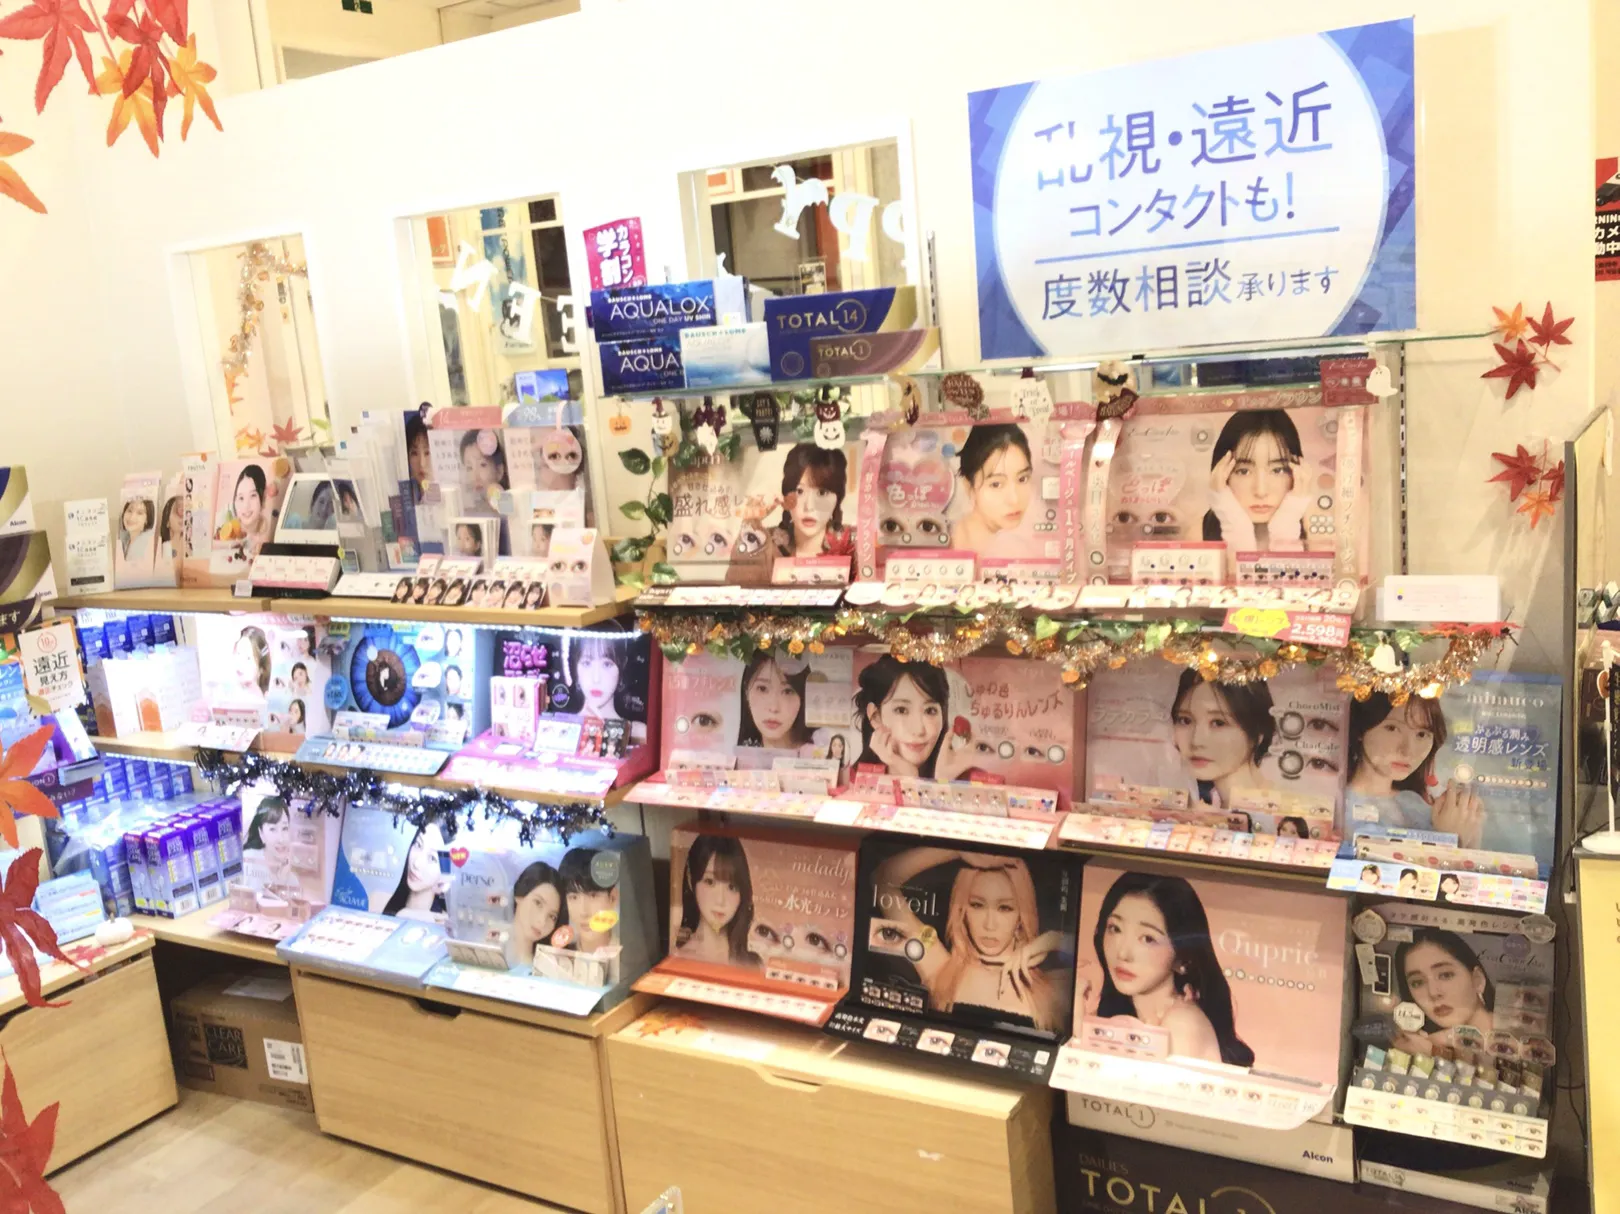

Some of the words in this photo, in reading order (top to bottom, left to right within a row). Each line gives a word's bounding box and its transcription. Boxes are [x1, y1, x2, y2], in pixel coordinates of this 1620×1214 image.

[597, 227, 621, 286] 学割
[617, 225, 634, 283] カラコン
[610, 296, 710, 321] AQUALOX
[653, 317, 667, 325] ONE
[776, 310, 839, 329] TOTAL
[818, 347, 854, 358] TOTAL
[674, 492, 764, 518] 盛れ感レ
[9, 519, 27, 528] Alcon
[33, 651, 70, 676] 遠近
[40, 671, 68, 686] 見え方
[970, 690, 1063, 719] ちゅるりんレンズ
[1454, 736, 1549, 757] 透明感レンズ
[461, 871, 495, 888] perse
[1081, 1097, 1135, 1120] TOTAL
[1302, 1149, 1334, 1164] Alcon
